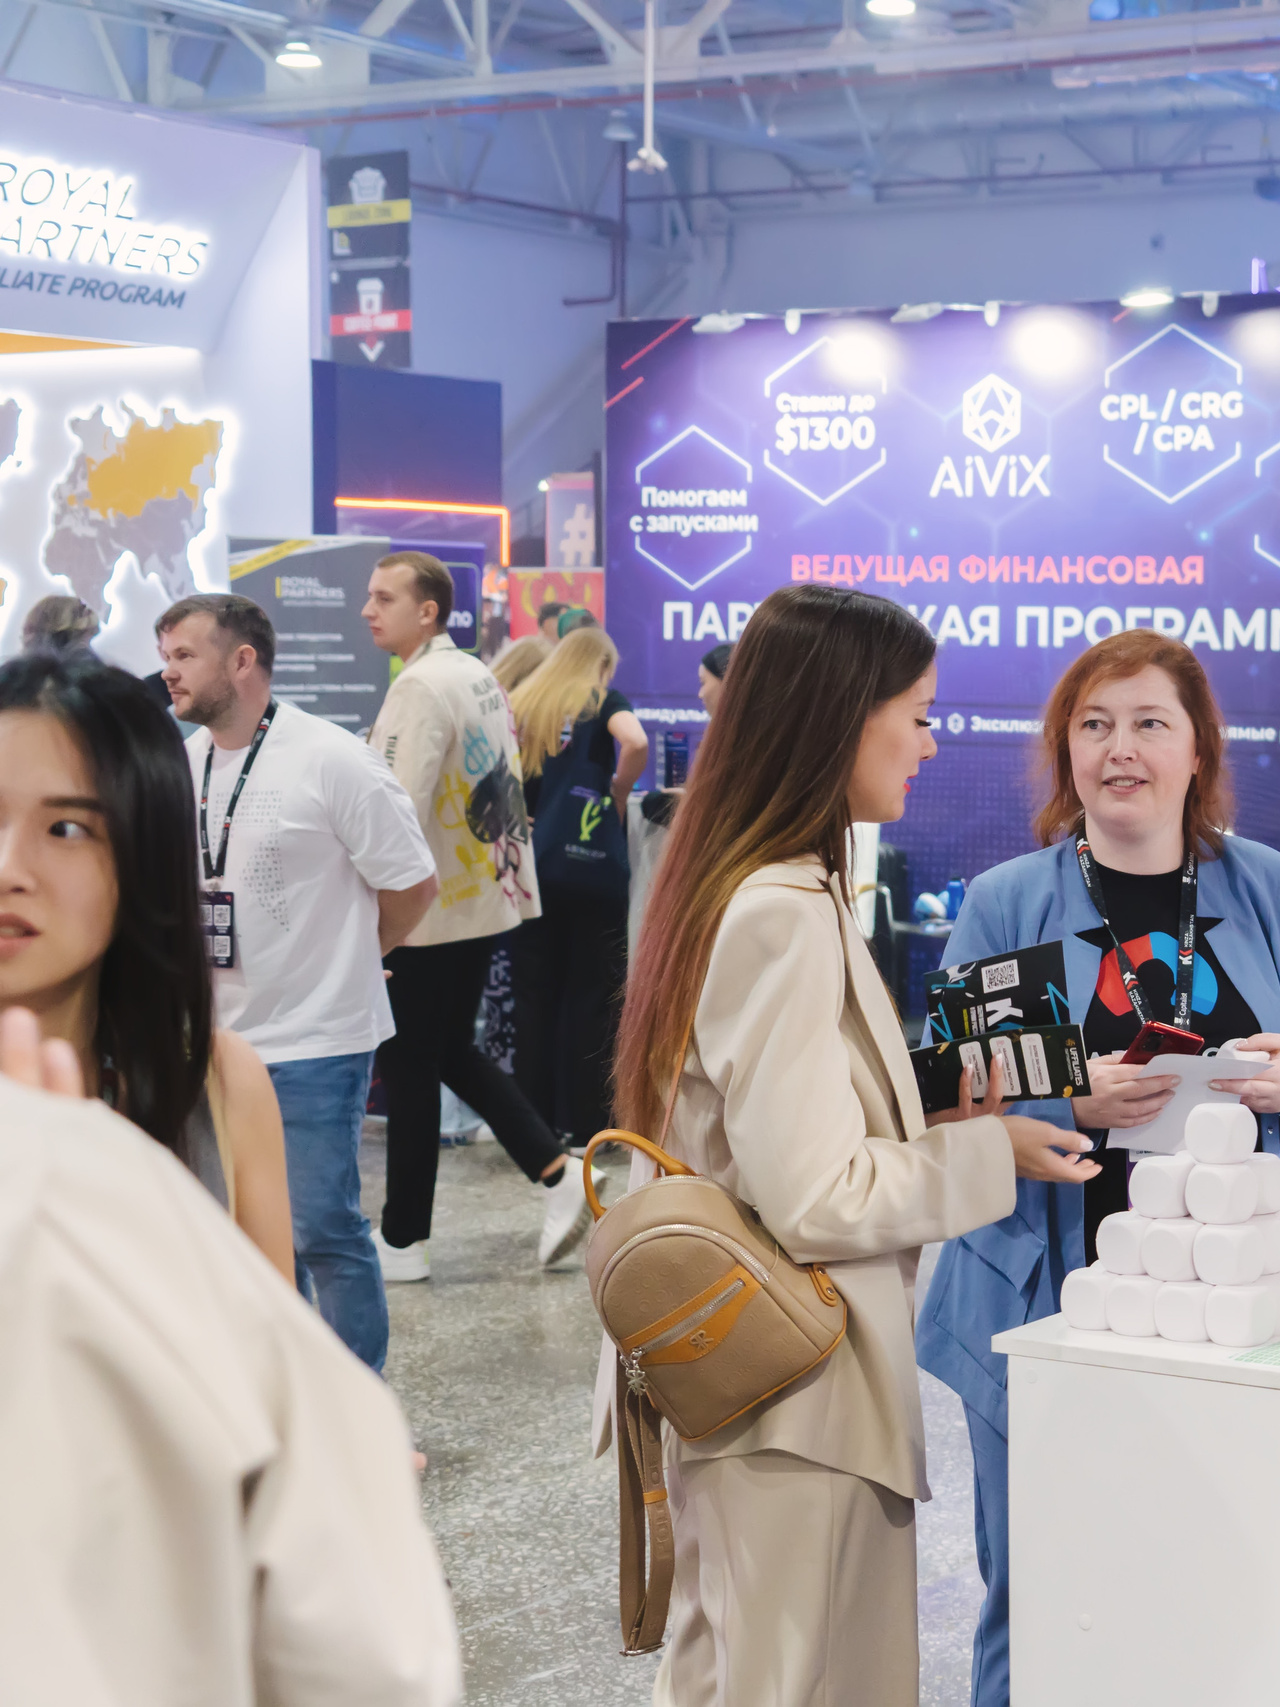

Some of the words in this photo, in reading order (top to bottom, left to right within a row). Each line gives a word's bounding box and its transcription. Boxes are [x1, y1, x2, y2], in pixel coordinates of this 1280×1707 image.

[68, 276, 187, 308] PROGRAM
[848, 394, 876, 414] до
[775, 415, 876, 455] $1300
[641, 487, 747, 508] Помогаем
[629, 516, 643, 533] с
[647, 514, 758, 537] запусками
[791, 554, 949, 586] ВЕДУЩАЯ
[958, 554, 1204, 586] ФИНАНСОВАЯ
[1069, 1047, 1083, 1086] UFFILIATES
